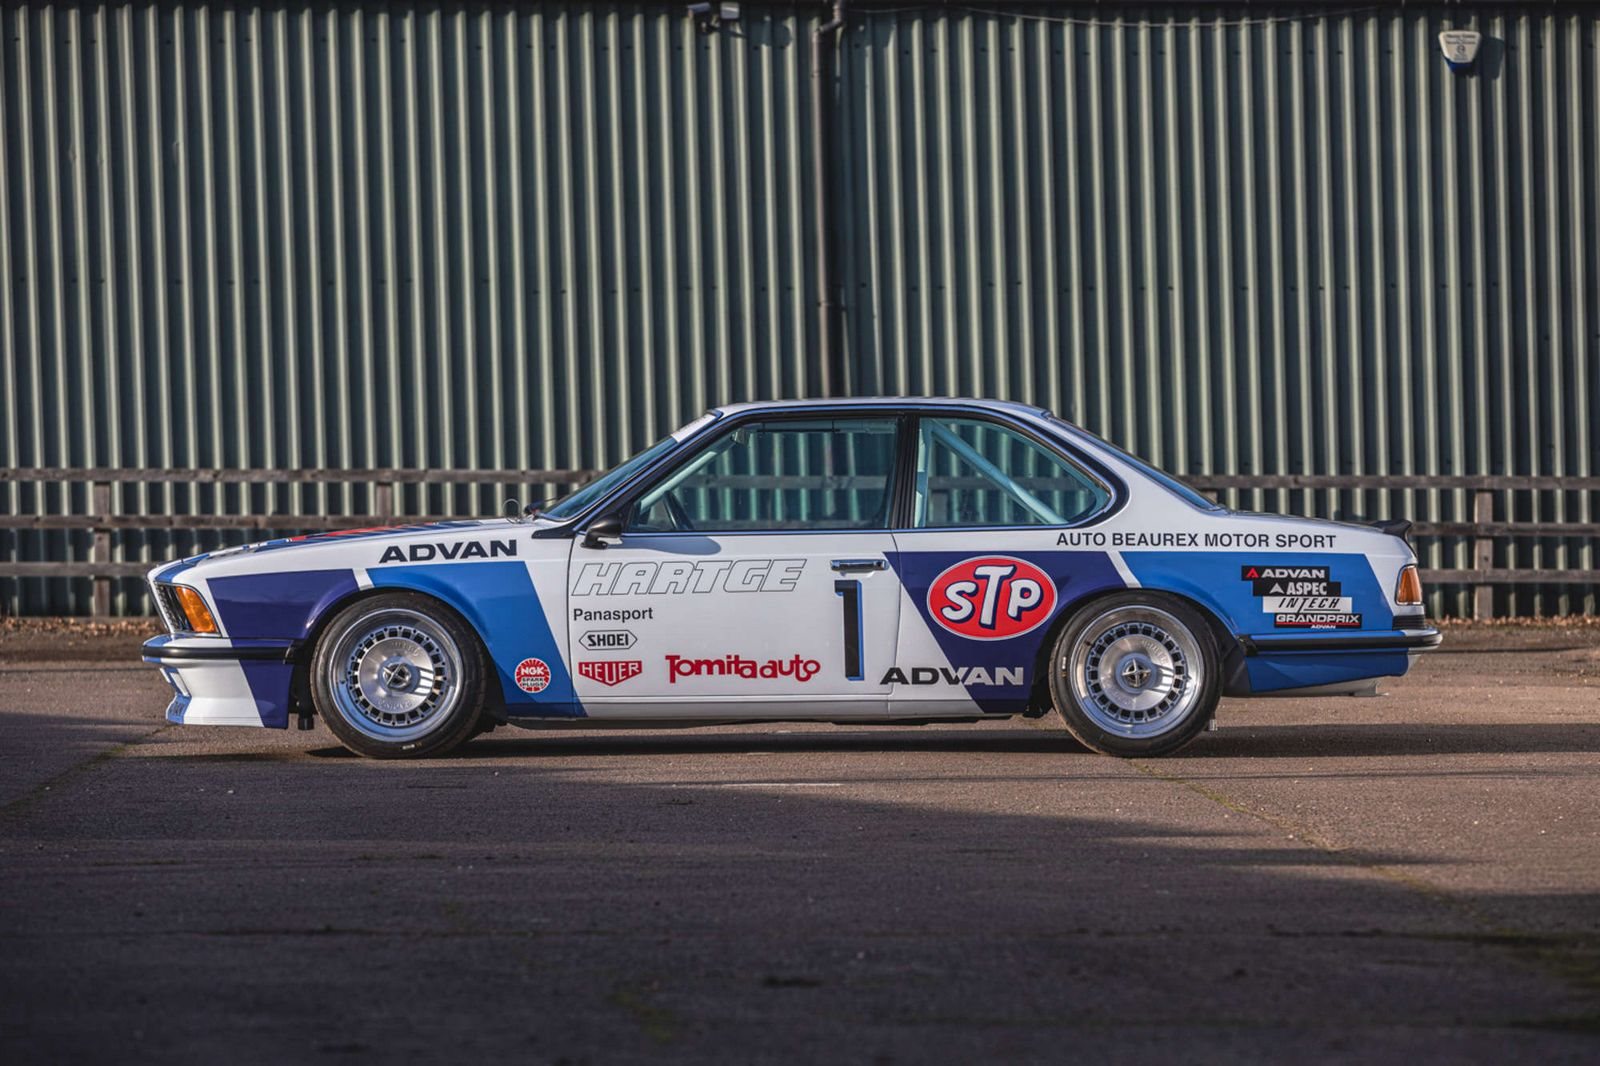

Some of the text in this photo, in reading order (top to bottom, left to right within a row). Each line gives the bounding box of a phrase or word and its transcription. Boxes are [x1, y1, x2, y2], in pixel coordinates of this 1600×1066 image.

[1056, 532, 1336, 549] AUTO BEAUREX MOTOR SPORT
[379, 539, 518, 564] ADVAN
[571, 559, 807, 596] HARTGE
[1261, 568, 1325, 579] ADVAN
[940, 564, 1044, 630] STP
[1286, 582, 1328, 595] ASPEC
[1278, 597, 1341, 613] INTECH
[573, 607, 653, 623] Panasport
[834, 580, 865, 681] 1
[587, 633, 629, 647] SHOEI
[520, 666, 545, 676] NGK
[581, 662, 640, 683] HEUER
[880, 667, 1024, 686] ADVAN
